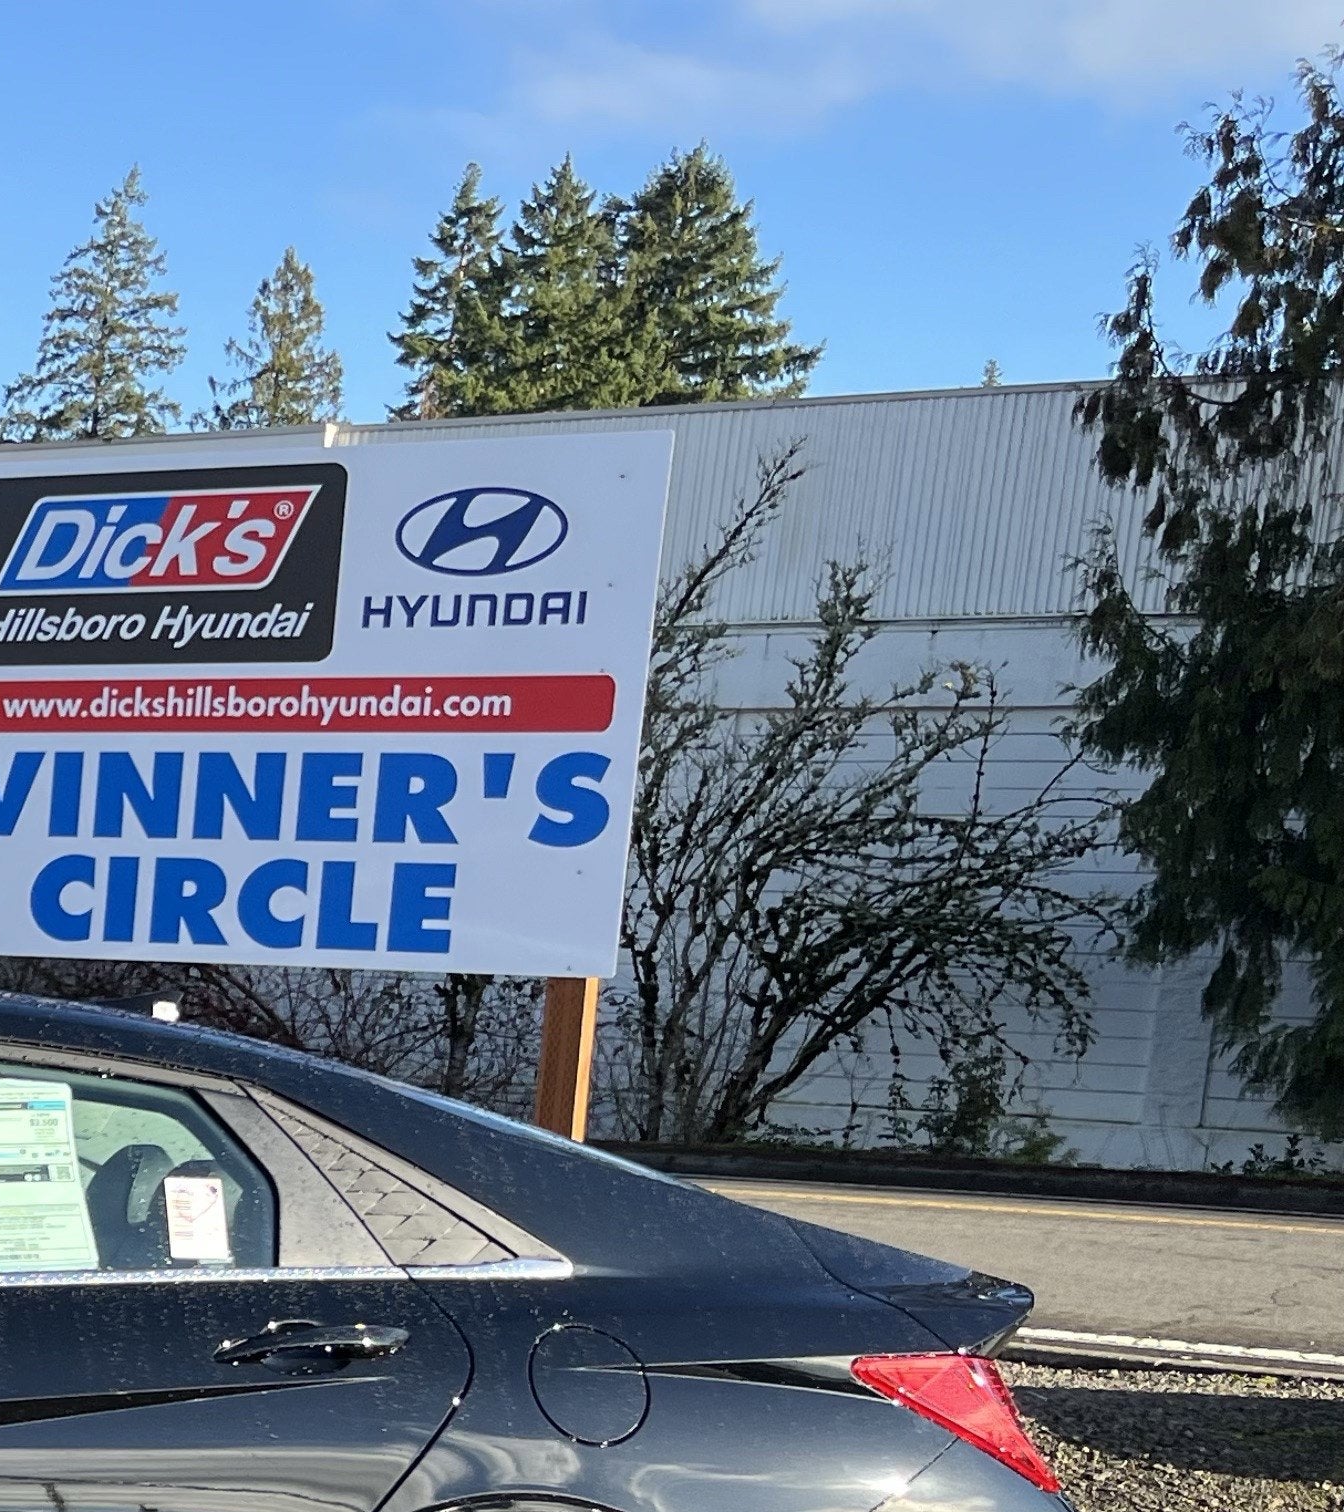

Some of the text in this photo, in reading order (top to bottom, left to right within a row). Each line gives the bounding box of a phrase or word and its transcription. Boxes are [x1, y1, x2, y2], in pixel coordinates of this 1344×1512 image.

[150, 602, 314, 648] Hyundai
[362, 590, 587, 629] HYUNDAI
[3, 685, 511, 727] www.dickshillsborohyundai.com
[30, 854, 456, 954] CIRCLE
